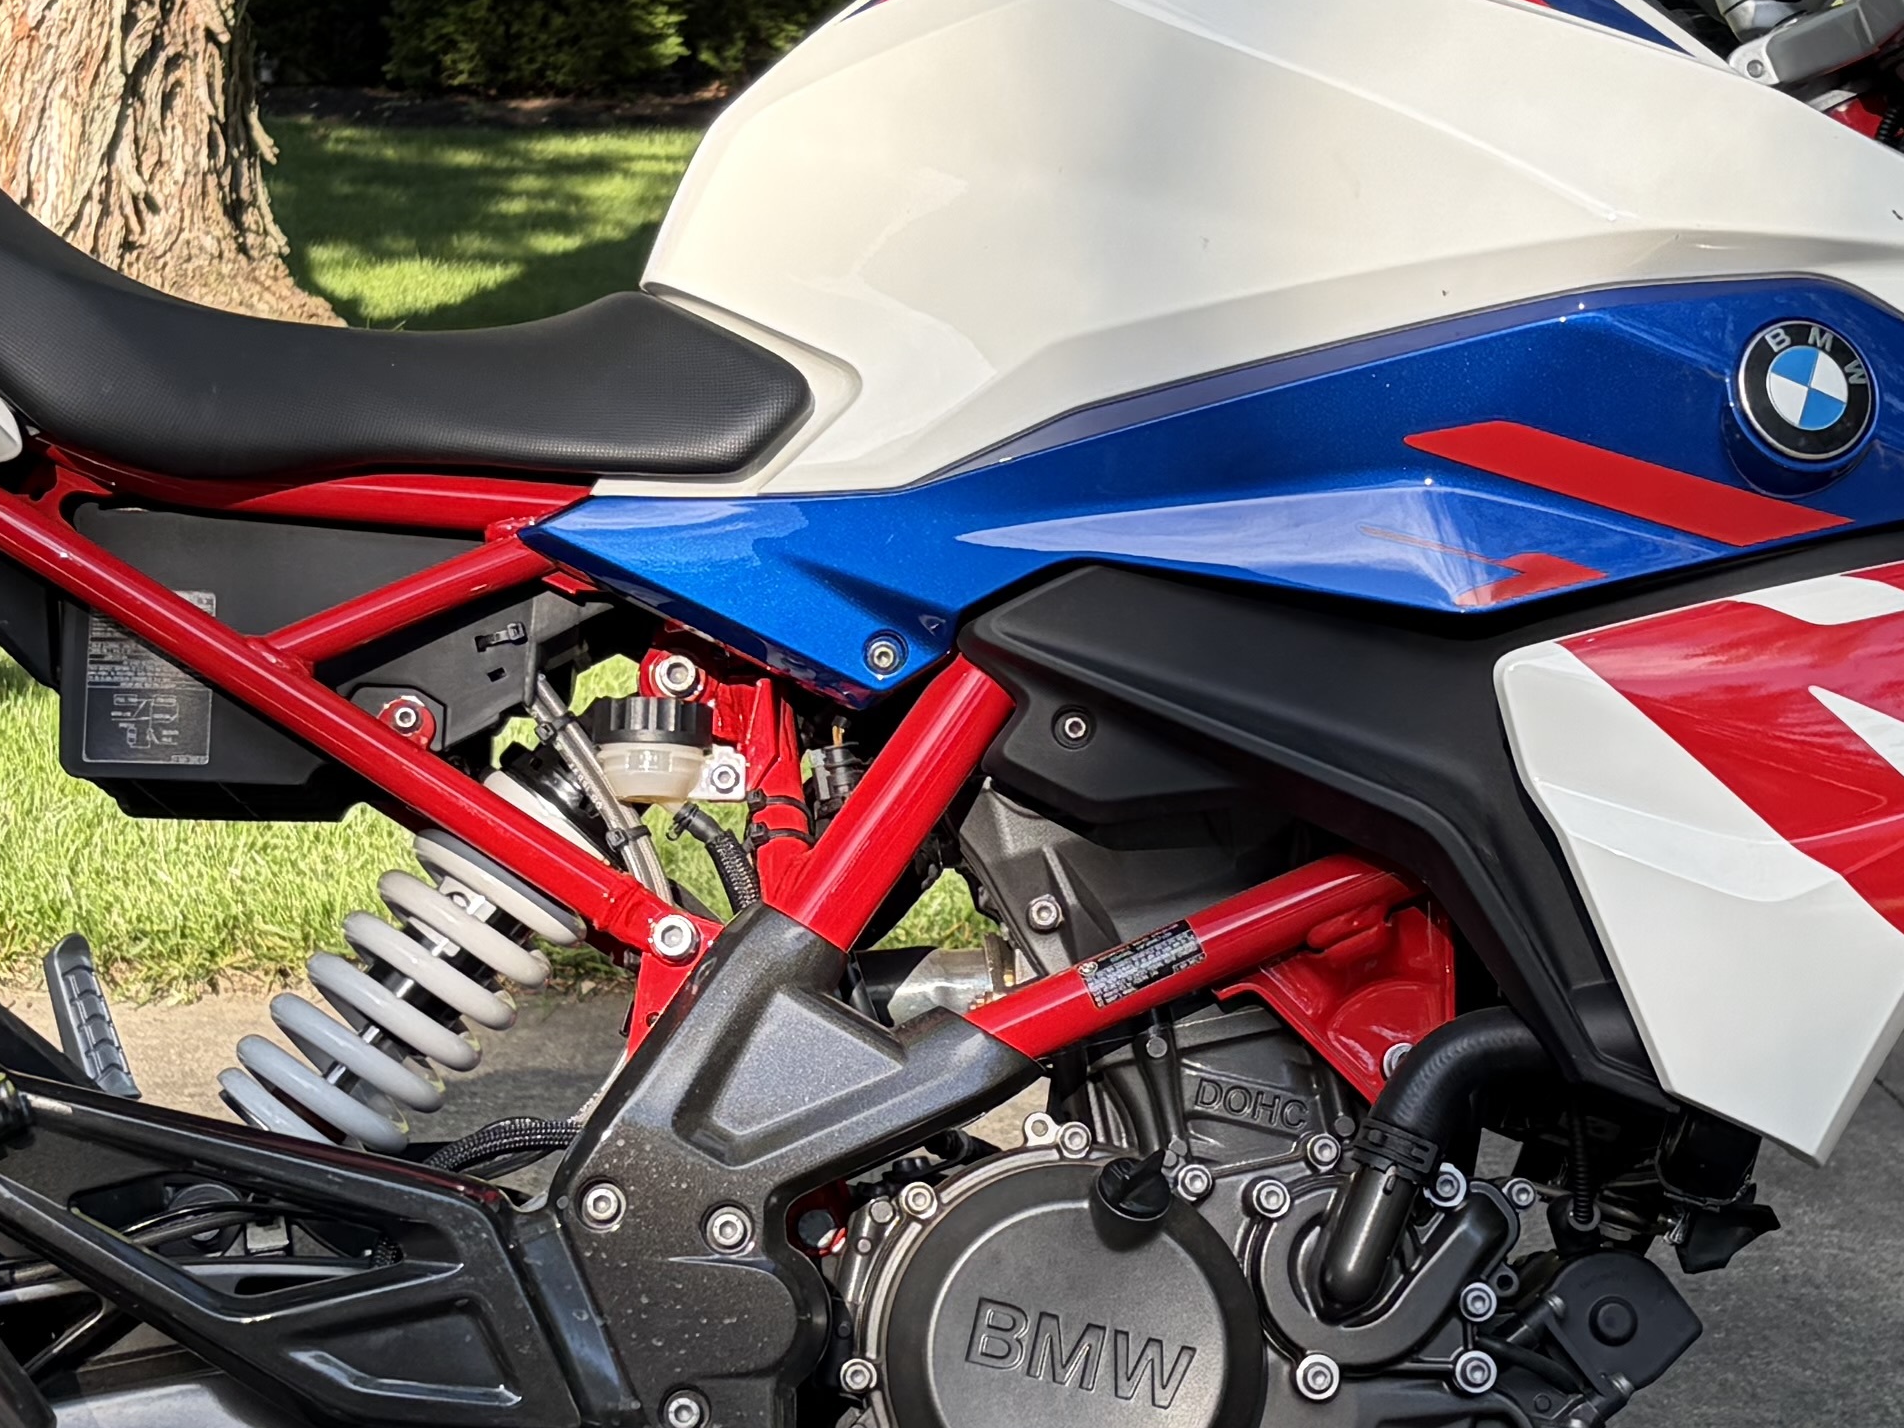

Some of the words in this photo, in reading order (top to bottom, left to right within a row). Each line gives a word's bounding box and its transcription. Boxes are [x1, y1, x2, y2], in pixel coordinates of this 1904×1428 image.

[1765, 326, 1869, 386] BMW
[1195, 1077, 1310, 1130] DOHC
[965, 1297, 1197, 1410] BMW
